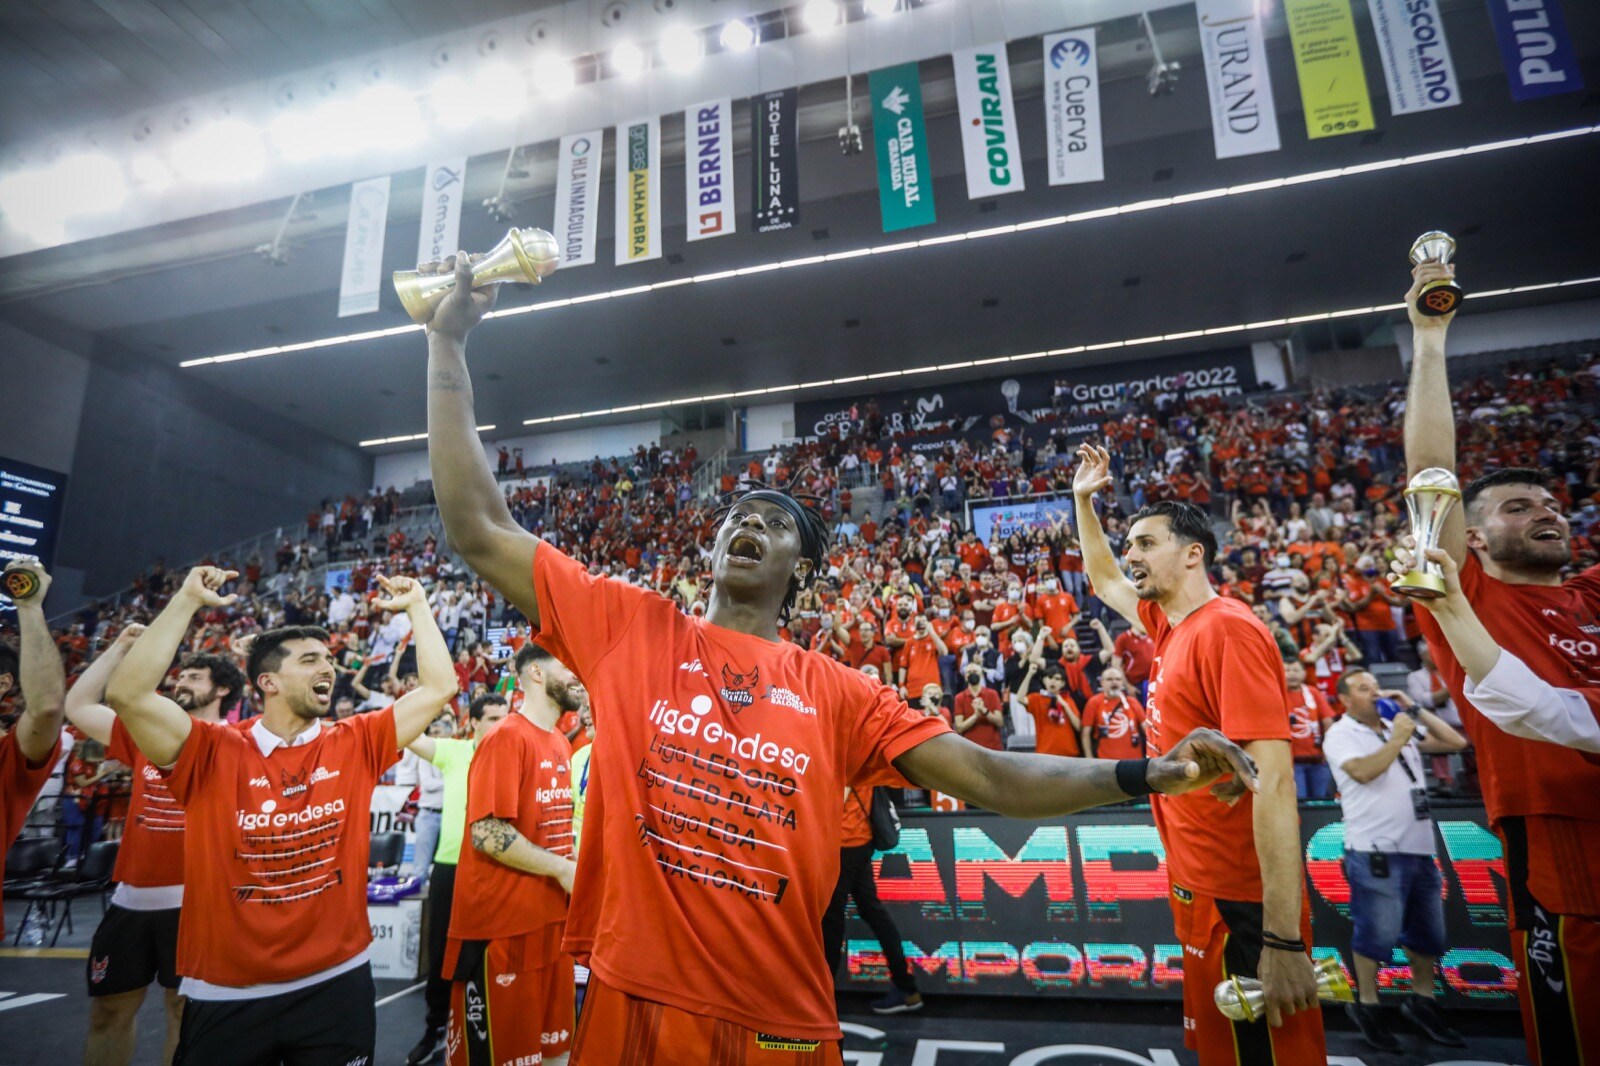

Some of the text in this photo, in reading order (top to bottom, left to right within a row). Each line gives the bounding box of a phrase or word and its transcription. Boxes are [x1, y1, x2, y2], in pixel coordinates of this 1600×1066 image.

[1202, 15, 1259, 134] JURAND
[1065, 75, 1090, 153] Cuerva
[698, 105, 722, 207] BERNER
[769, 100, 781, 208] HOTEL LUNA
[896, 117, 920, 208] CAJA RURAL
[633, 172, 646, 256] ALHAMBRA
[1185, 366, 1237, 388] 2022
[649, 699, 811, 775] liga endesa
[649, 734, 797, 797] Liga LEB ORO
[273, 799, 345, 827] endesa
[660, 802, 756, 851] Liga EBA
[672, 774, 721, 806] LEB
[725, 791, 797, 831] PLATA
[656, 852, 768, 901] NACIONAL
